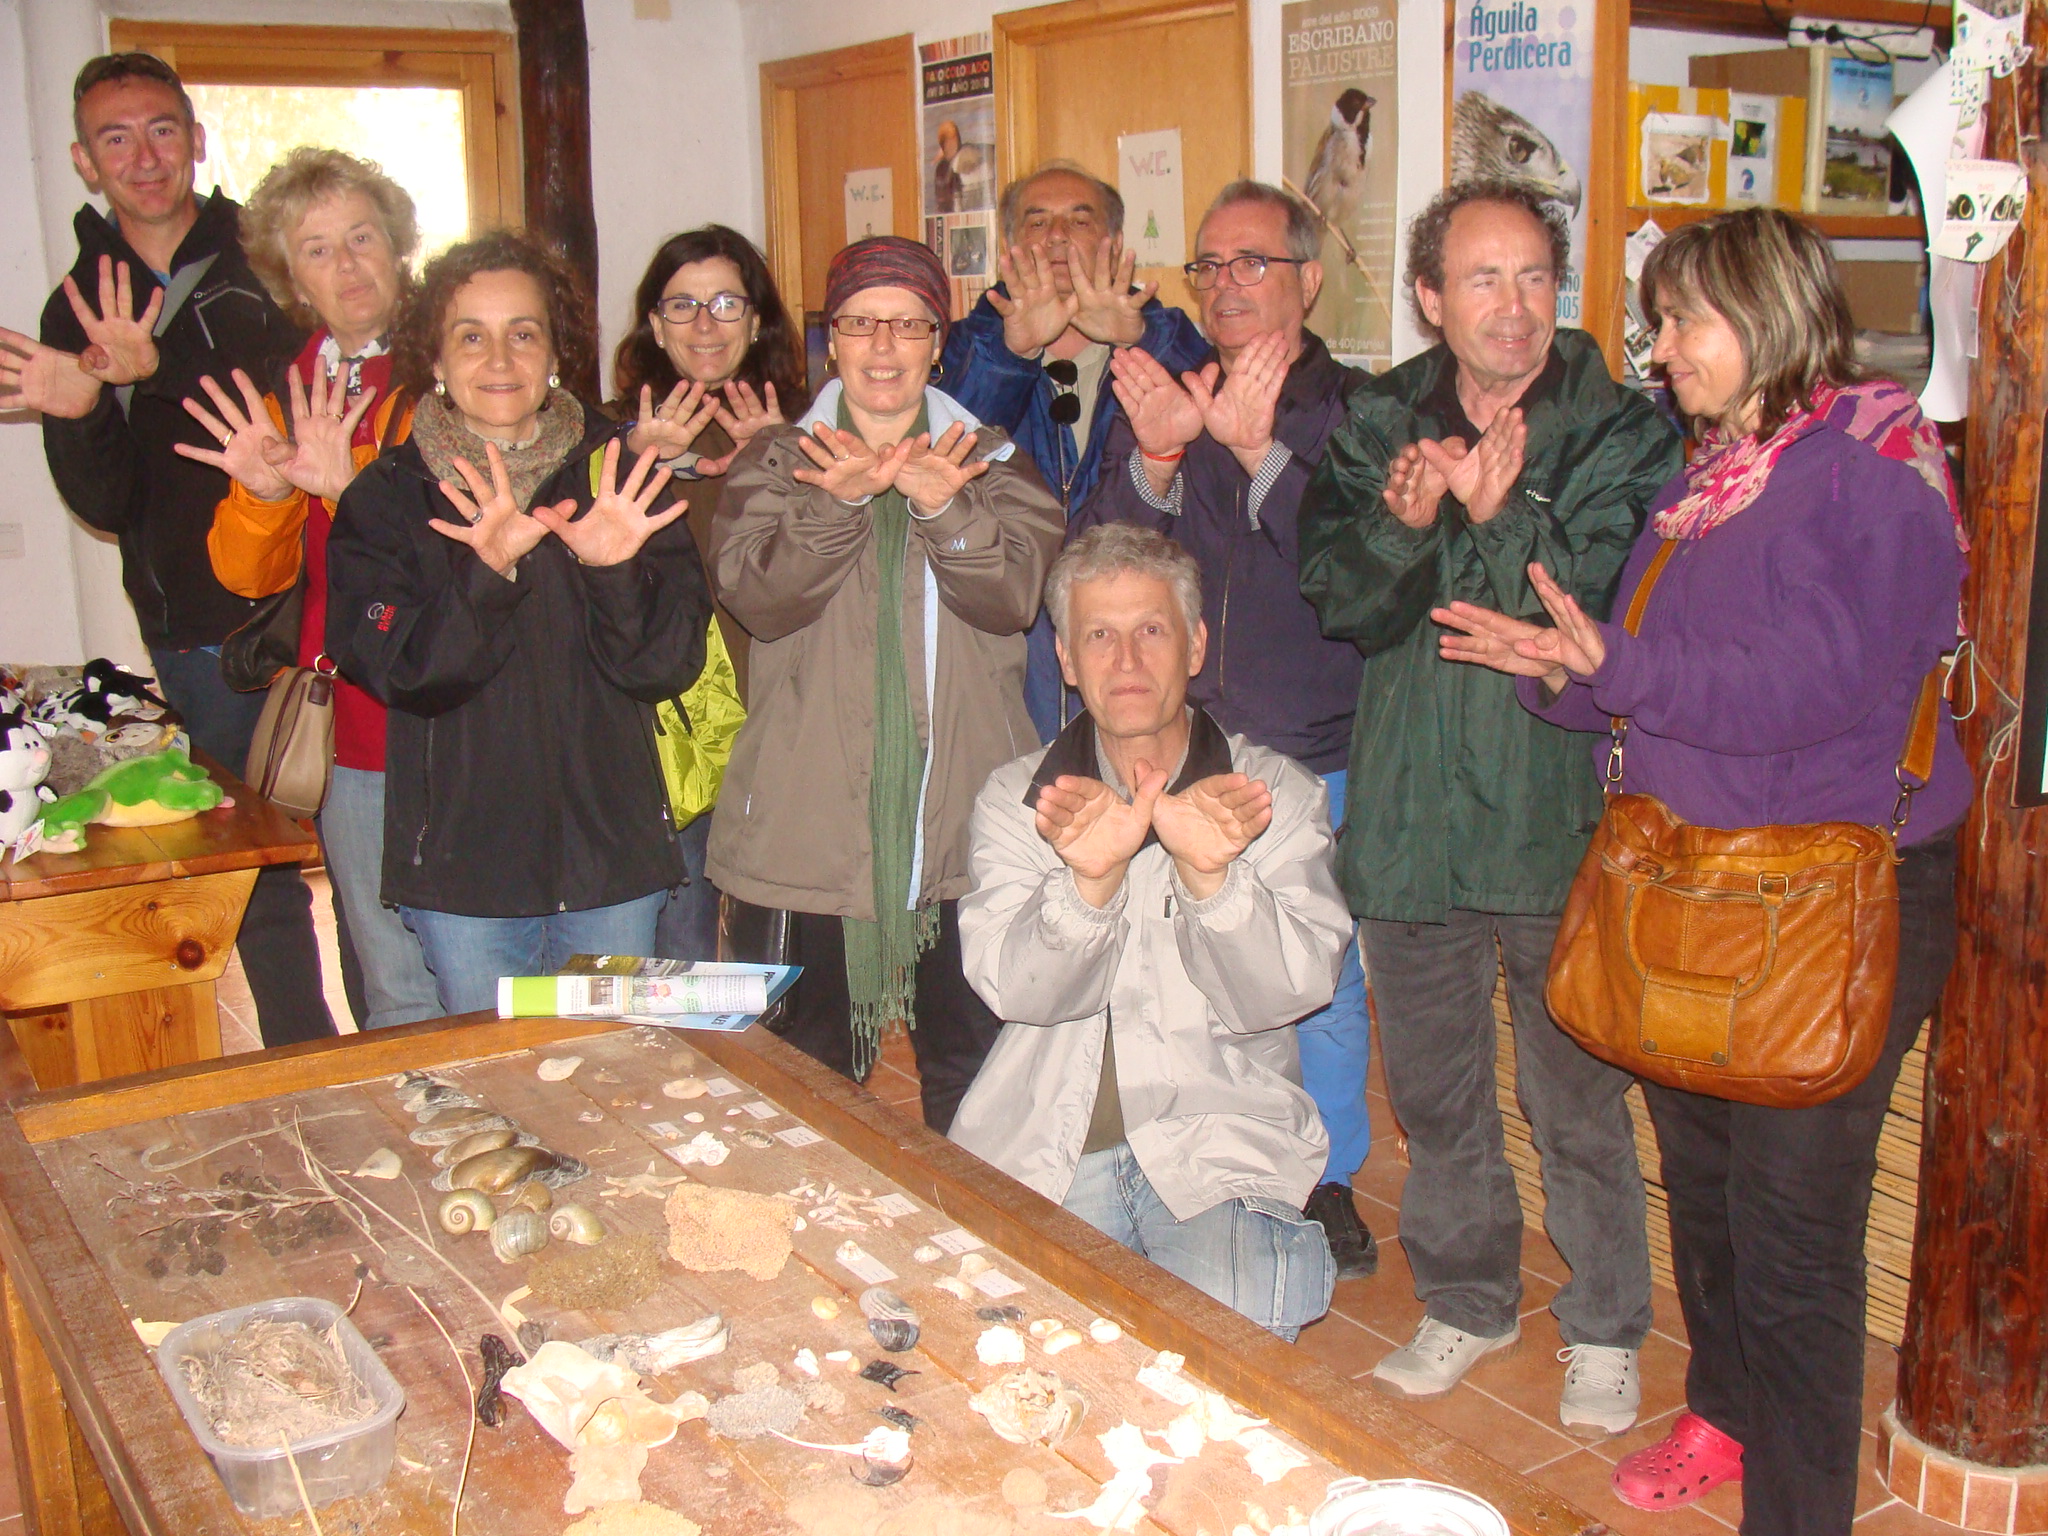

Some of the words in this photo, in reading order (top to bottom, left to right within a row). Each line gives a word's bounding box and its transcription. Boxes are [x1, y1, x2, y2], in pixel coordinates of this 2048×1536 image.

[1288, 20, 1394, 54] ESCRIBANO
[1470, 0, 1537, 41] Águila
[1289, 45, 1394, 79] PALUSTRE
[1469, 37, 1571, 73] Perdicera
[1556, 295, 1579, 319] 005
[1326, 337, 1337, 349] de
[1338, 337, 1355, 349] 400
